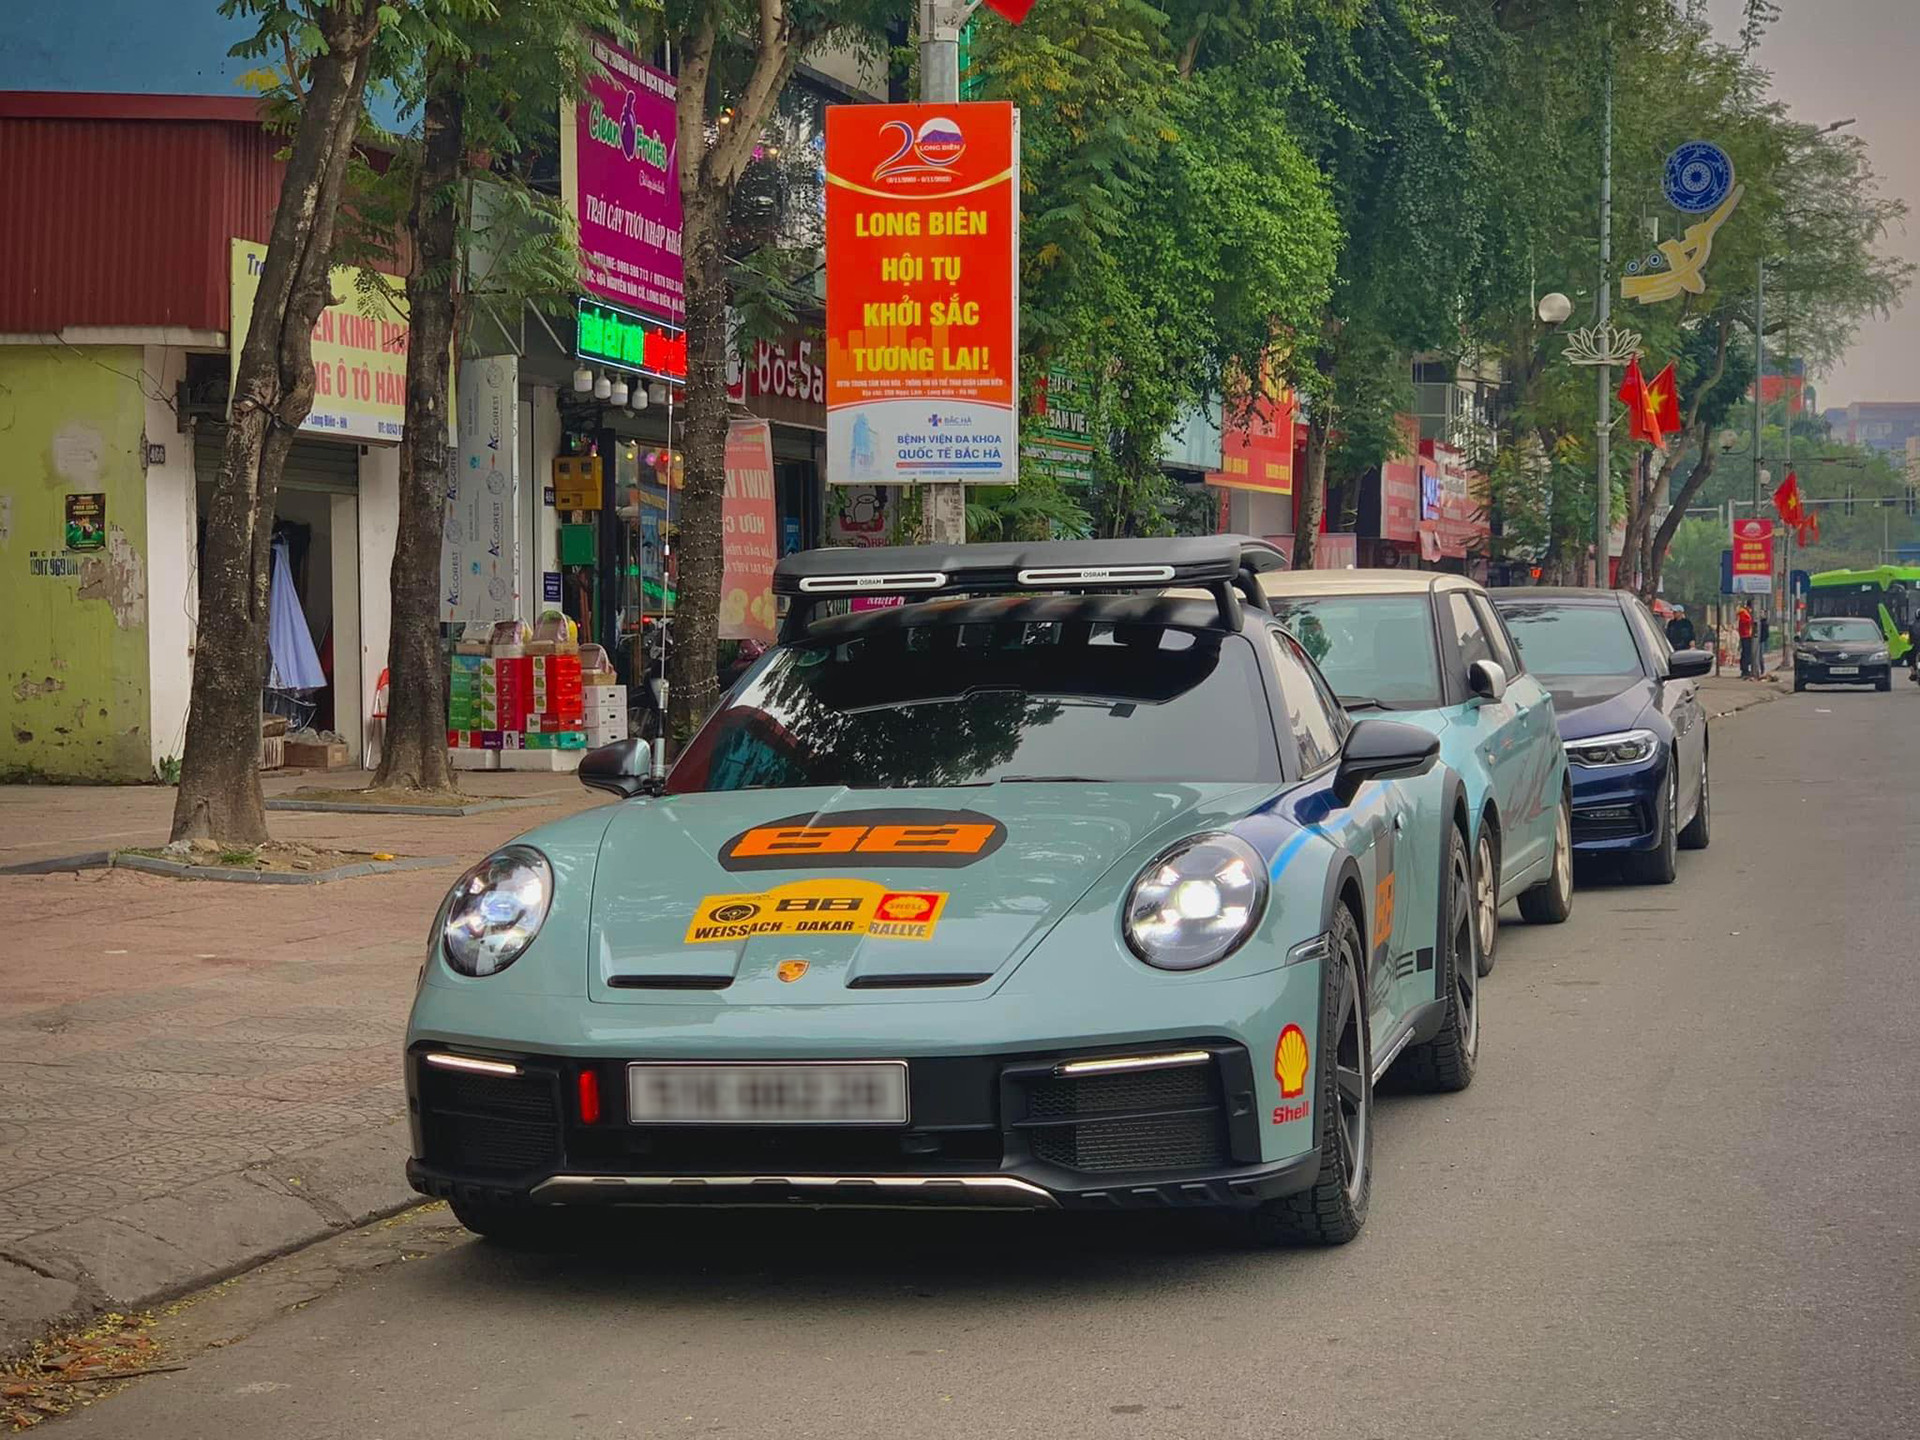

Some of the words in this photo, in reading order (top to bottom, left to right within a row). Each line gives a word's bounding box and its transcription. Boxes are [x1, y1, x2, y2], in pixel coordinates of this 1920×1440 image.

[589, 99, 621, 149] Clean
[942, 143, 960, 151] BIÊN
[625, 210, 643, 241] TƯƠI
[644, 217, 665, 255] NHẬP
[666, 222, 682, 256] KHẨ
[856, 212, 920, 237] LONG
[929, 206, 987, 235] BIÊN
[882, 252, 923, 286] HỘI
[931, 257, 961, 286] TỤ
[864, 295, 921, 327] KHỞI
[930, 292, 980, 326] SẮC
[339, 313, 376, 350] KINH
[854, 345, 934, 372] TƯƠNG
[943, 347, 989, 371] LAI!
[337, 358, 347, 398] Ô
[352, 362, 370, 402] TÔ
[897, 433, 926, 447] BỆNH
[929, 433, 953, 447] VIỆN
[955, 435, 970, 444] ĐA
[972, 435, 1001, 444] KHOA
[898, 446, 931, 459] QUỐC
[938, 446, 952, 459] TẾ
[983, 446, 1001, 458] HÀ
[859, 578, 882, 586] OSRAM
[730, 824, 996, 857] 88
[775, 897, 863, 911] 88
[695, 921, 783, 939] WEISSACH
[796, 920, 854, 931] DAKAR
[869, 922, 927, 937] RALLYE
[1272, 1101, 1309, 1125] Shell
